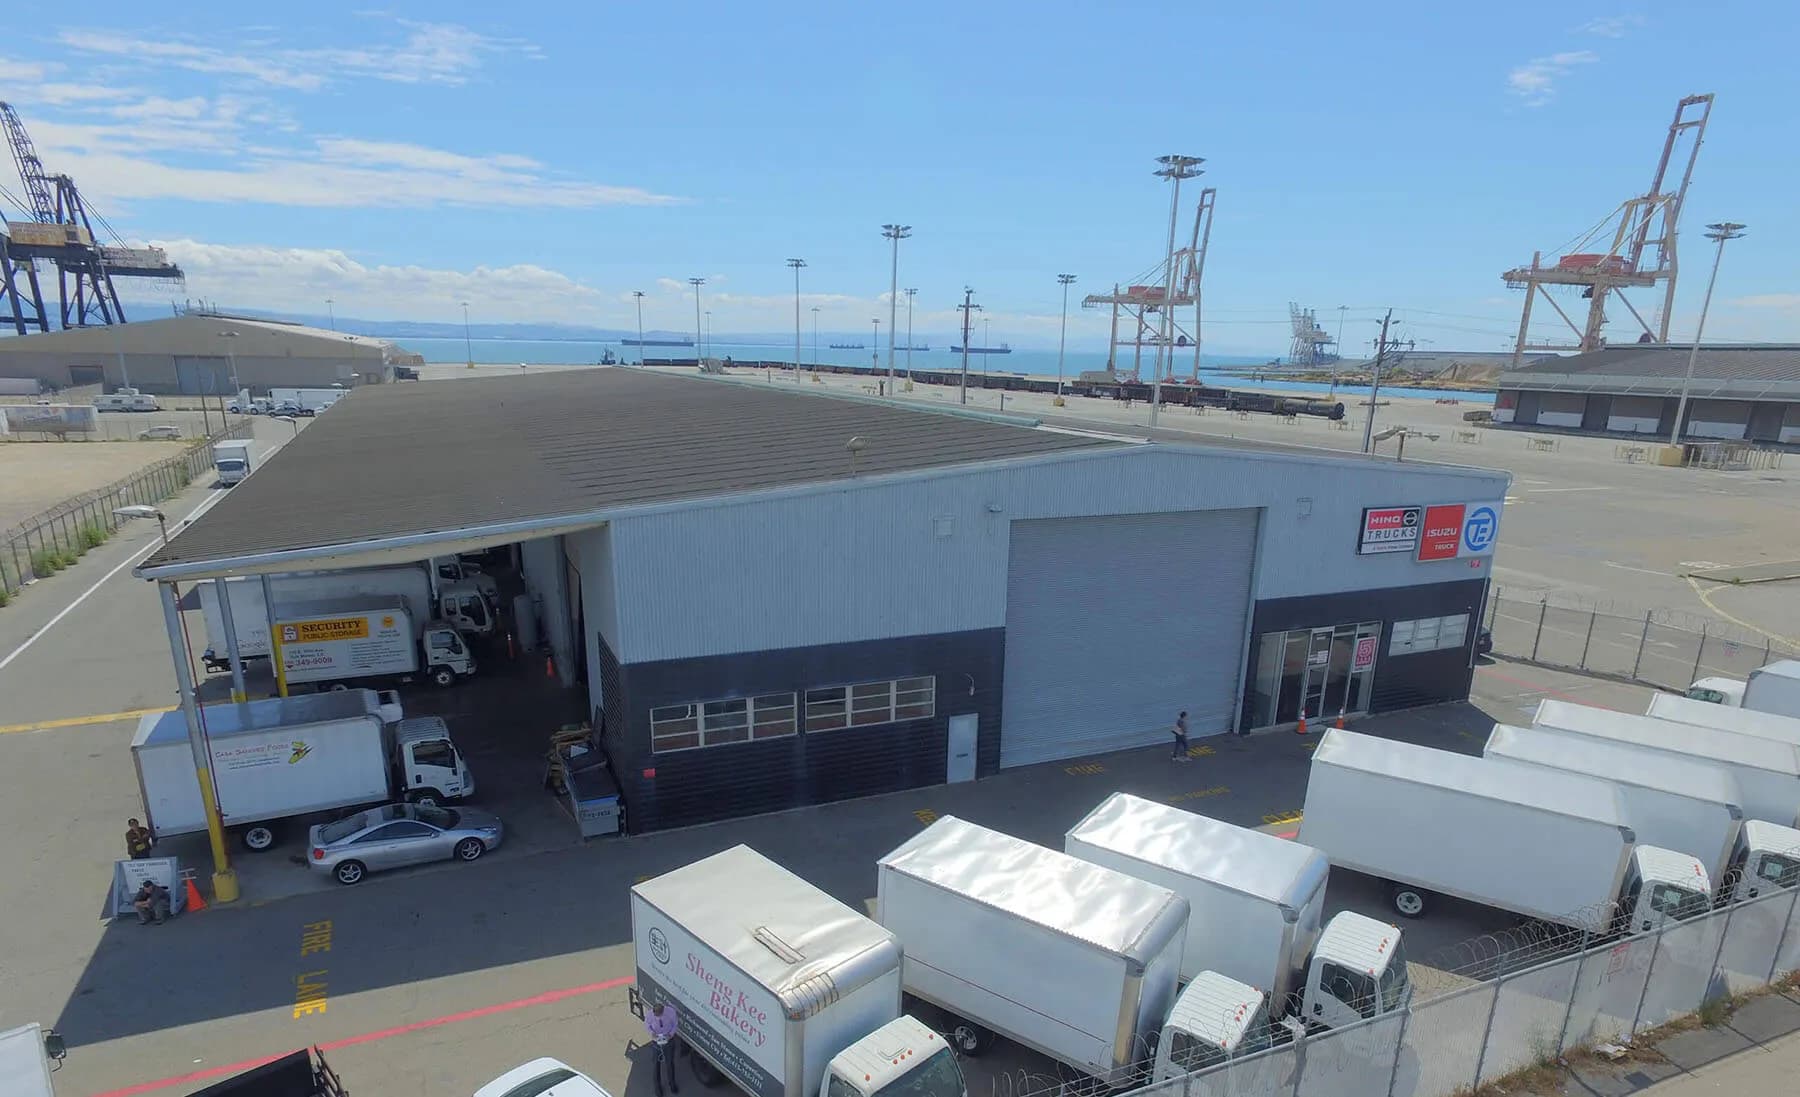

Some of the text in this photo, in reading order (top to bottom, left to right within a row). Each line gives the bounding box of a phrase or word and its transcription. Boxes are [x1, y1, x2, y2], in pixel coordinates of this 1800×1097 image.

[1370, 515, 1400, 525] HINO
[1367, 527, 1417, 540] TRUCKS
[1426, 527, 1458, 538] ISUZU
[1434, 543, 1455, 551] TRUCK
[301, 620, 361, 633] SECURITY
[303, 629, 363, 640] PUBLIC STORAGE
[293, 920, 332, 1019] FIRE LANE
[686, 952, 733, 1005] Sheng
[738, 991, 767, 1026] Kee
[710, 991, 767, 1048] Bakery
